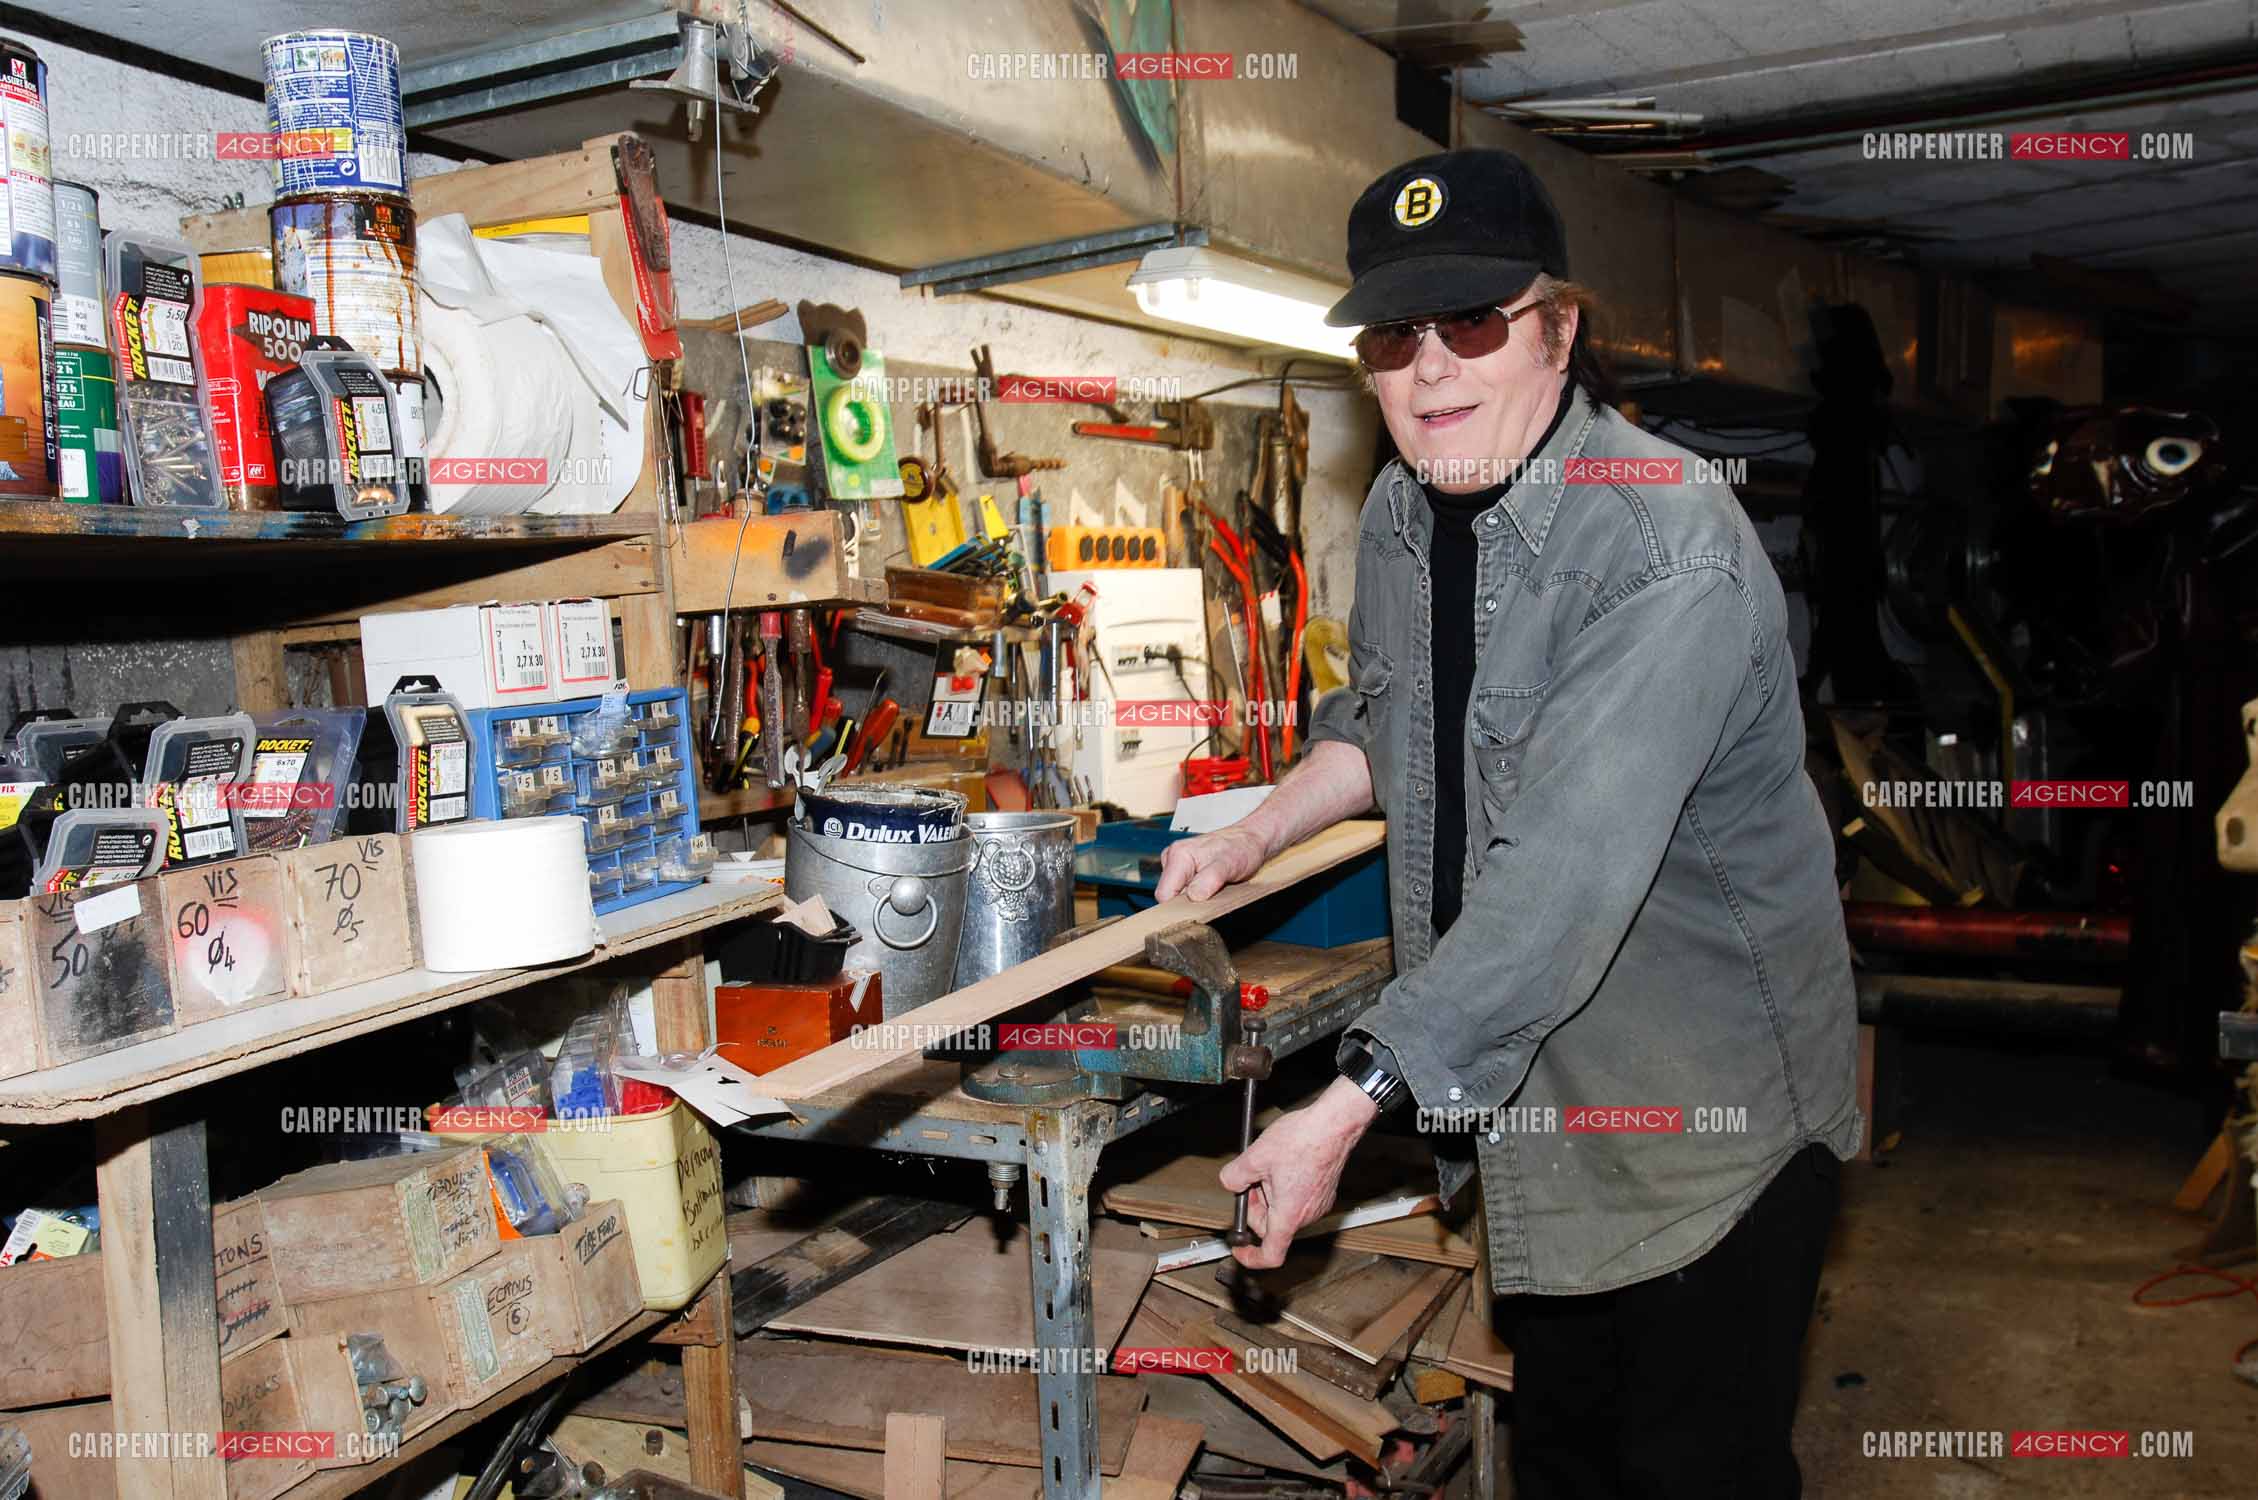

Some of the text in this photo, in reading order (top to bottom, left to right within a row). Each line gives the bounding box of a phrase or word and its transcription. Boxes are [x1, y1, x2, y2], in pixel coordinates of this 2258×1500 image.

[0, 74, 23, 87] ASURE
[1406, 186, 1432, 221] B
[248, 311, 311, 342] RIPOLIN
[264, 338, 301, 363] 500
[535, 654, 544, 666] 30
[598, 646, 606, 657] 30
[826, 822, 839, 831] ICI
[846, 822, 915, 843] Dulux
[314, 863, 362, 902] 70
[177, 901, 210, 939] 60
[51, 926, 89, 990] 50
[511, 1306, 521, 1326] 6
